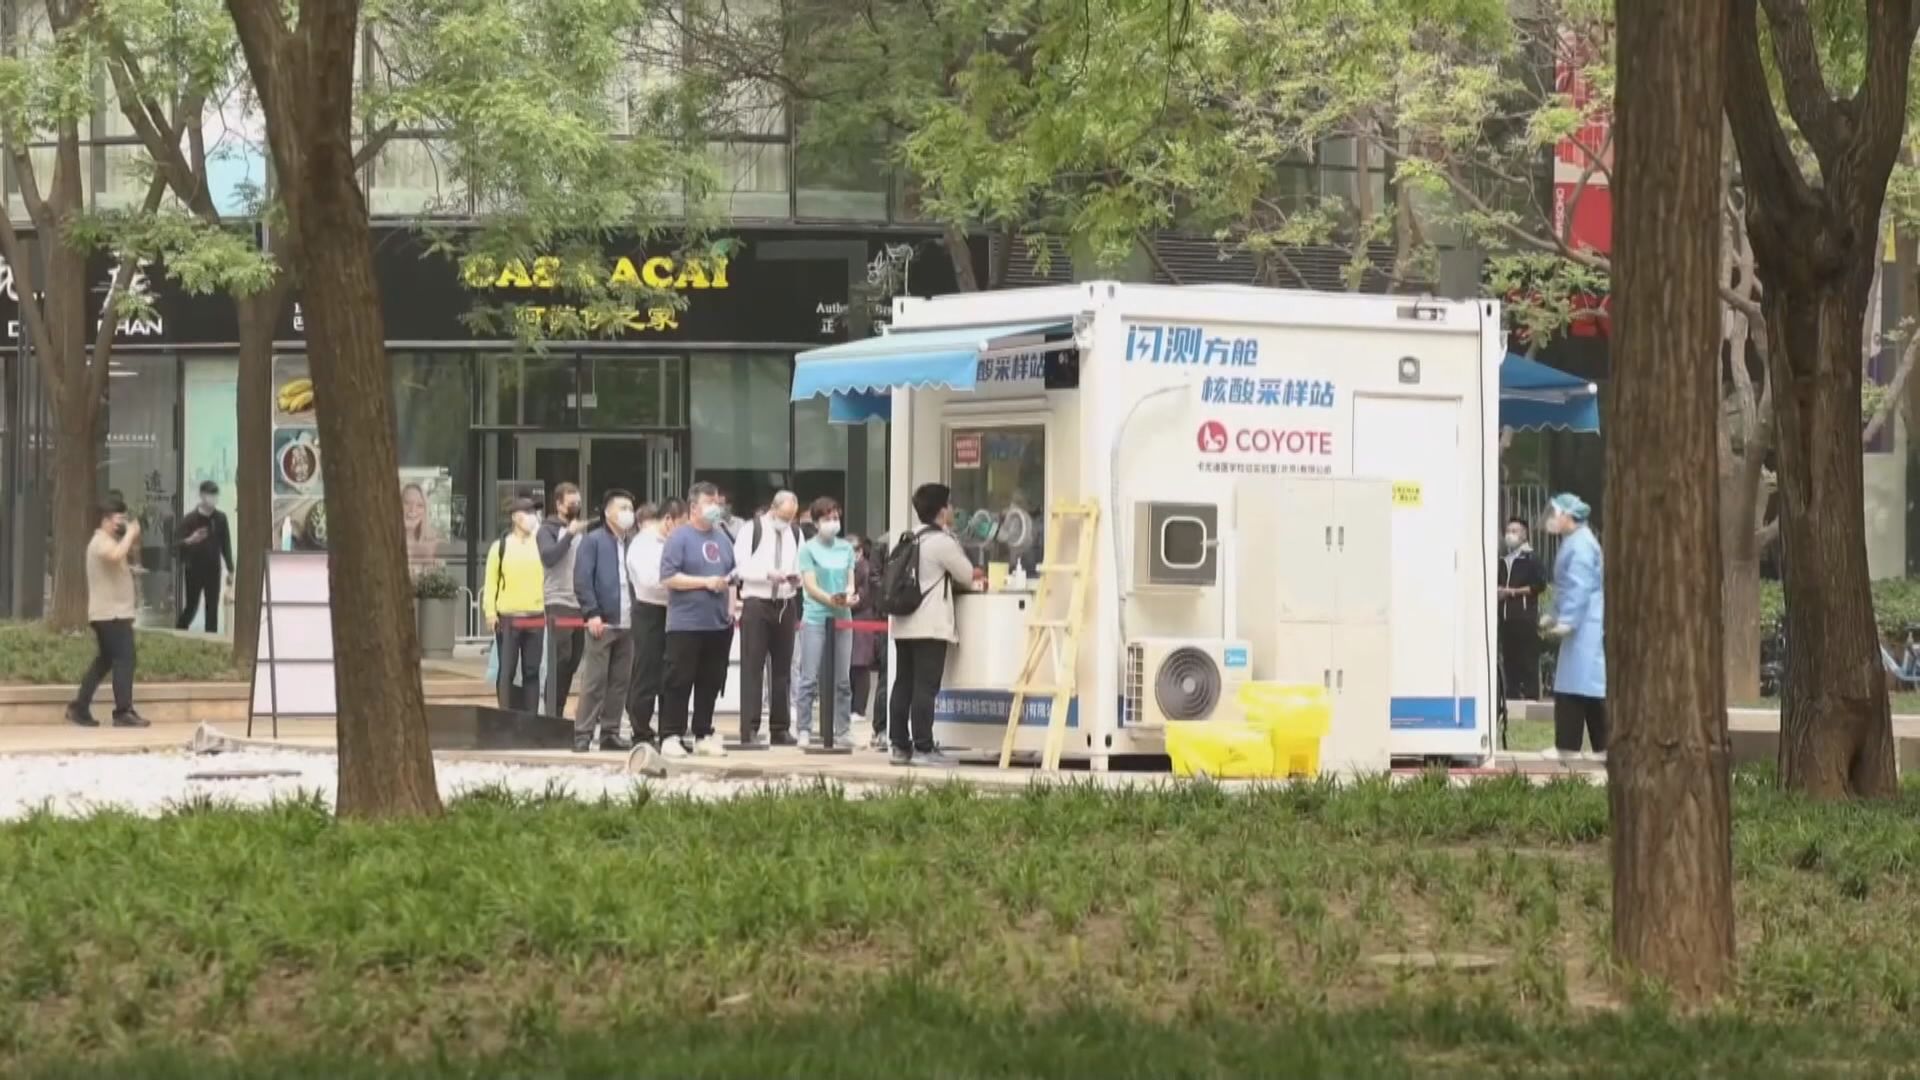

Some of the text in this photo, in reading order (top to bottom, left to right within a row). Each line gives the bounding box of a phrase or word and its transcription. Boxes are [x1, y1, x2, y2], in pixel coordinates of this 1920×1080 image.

[1125, 324, 1259, 367] 闪测方舱
[1201, 375, 1336, 408] 核酸采样站
[1235, 429, 1332, 455] COYOTE
